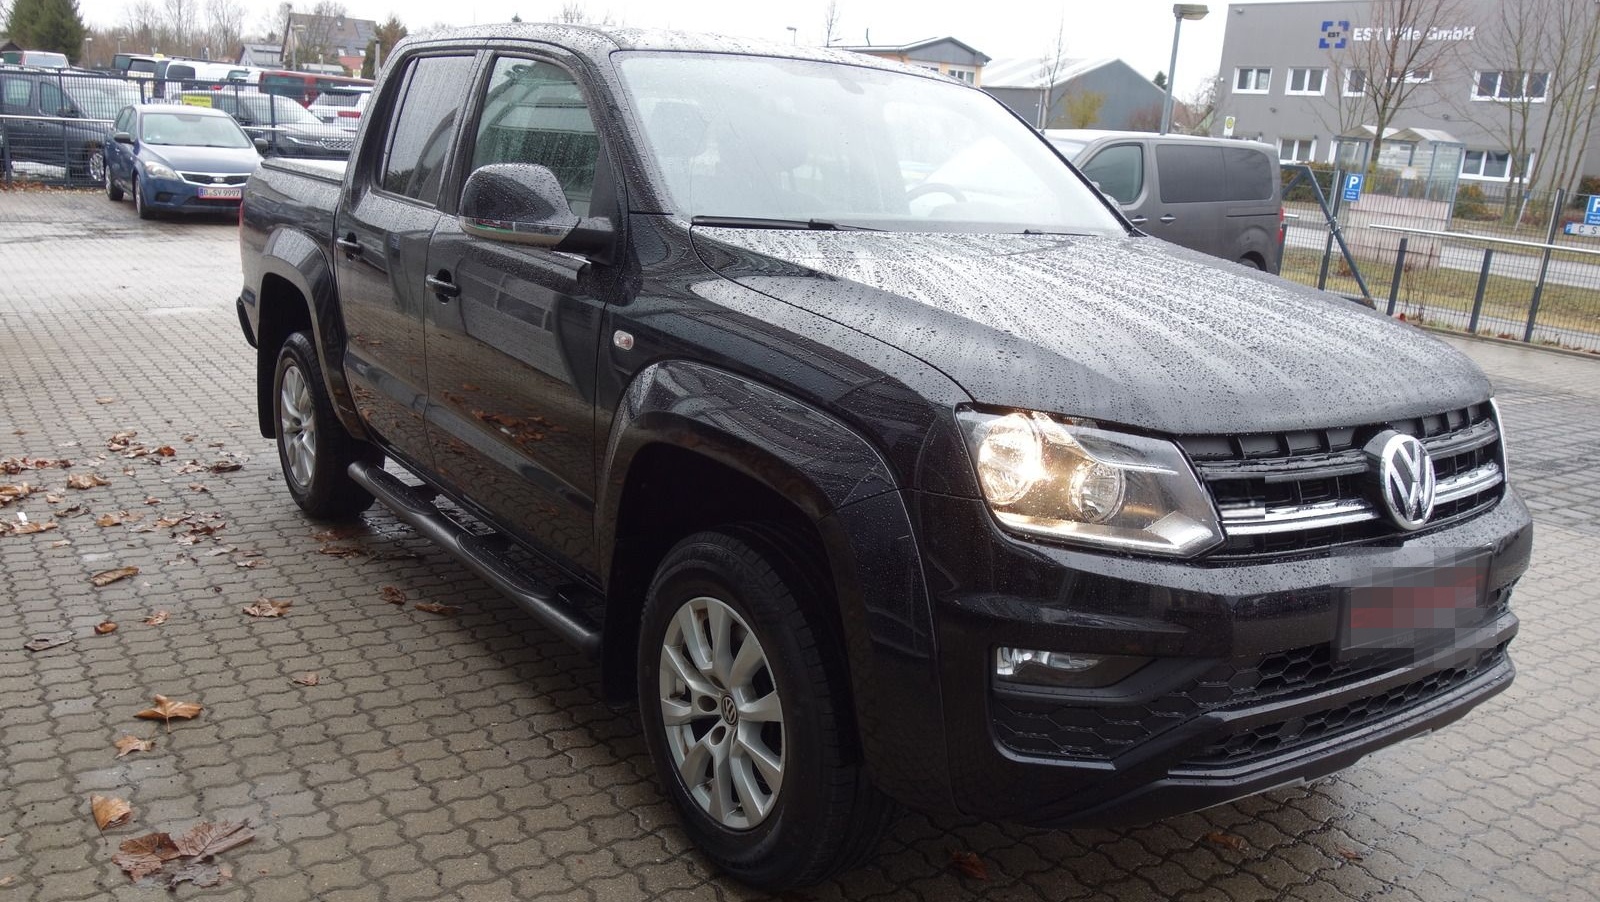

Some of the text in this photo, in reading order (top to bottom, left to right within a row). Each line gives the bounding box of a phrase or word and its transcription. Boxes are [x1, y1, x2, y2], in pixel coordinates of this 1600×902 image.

[1353, 27, 1382, 41] EST
[1427, 25, 1475, 41] GmbH
[1349, 176, 1359, 189] P
